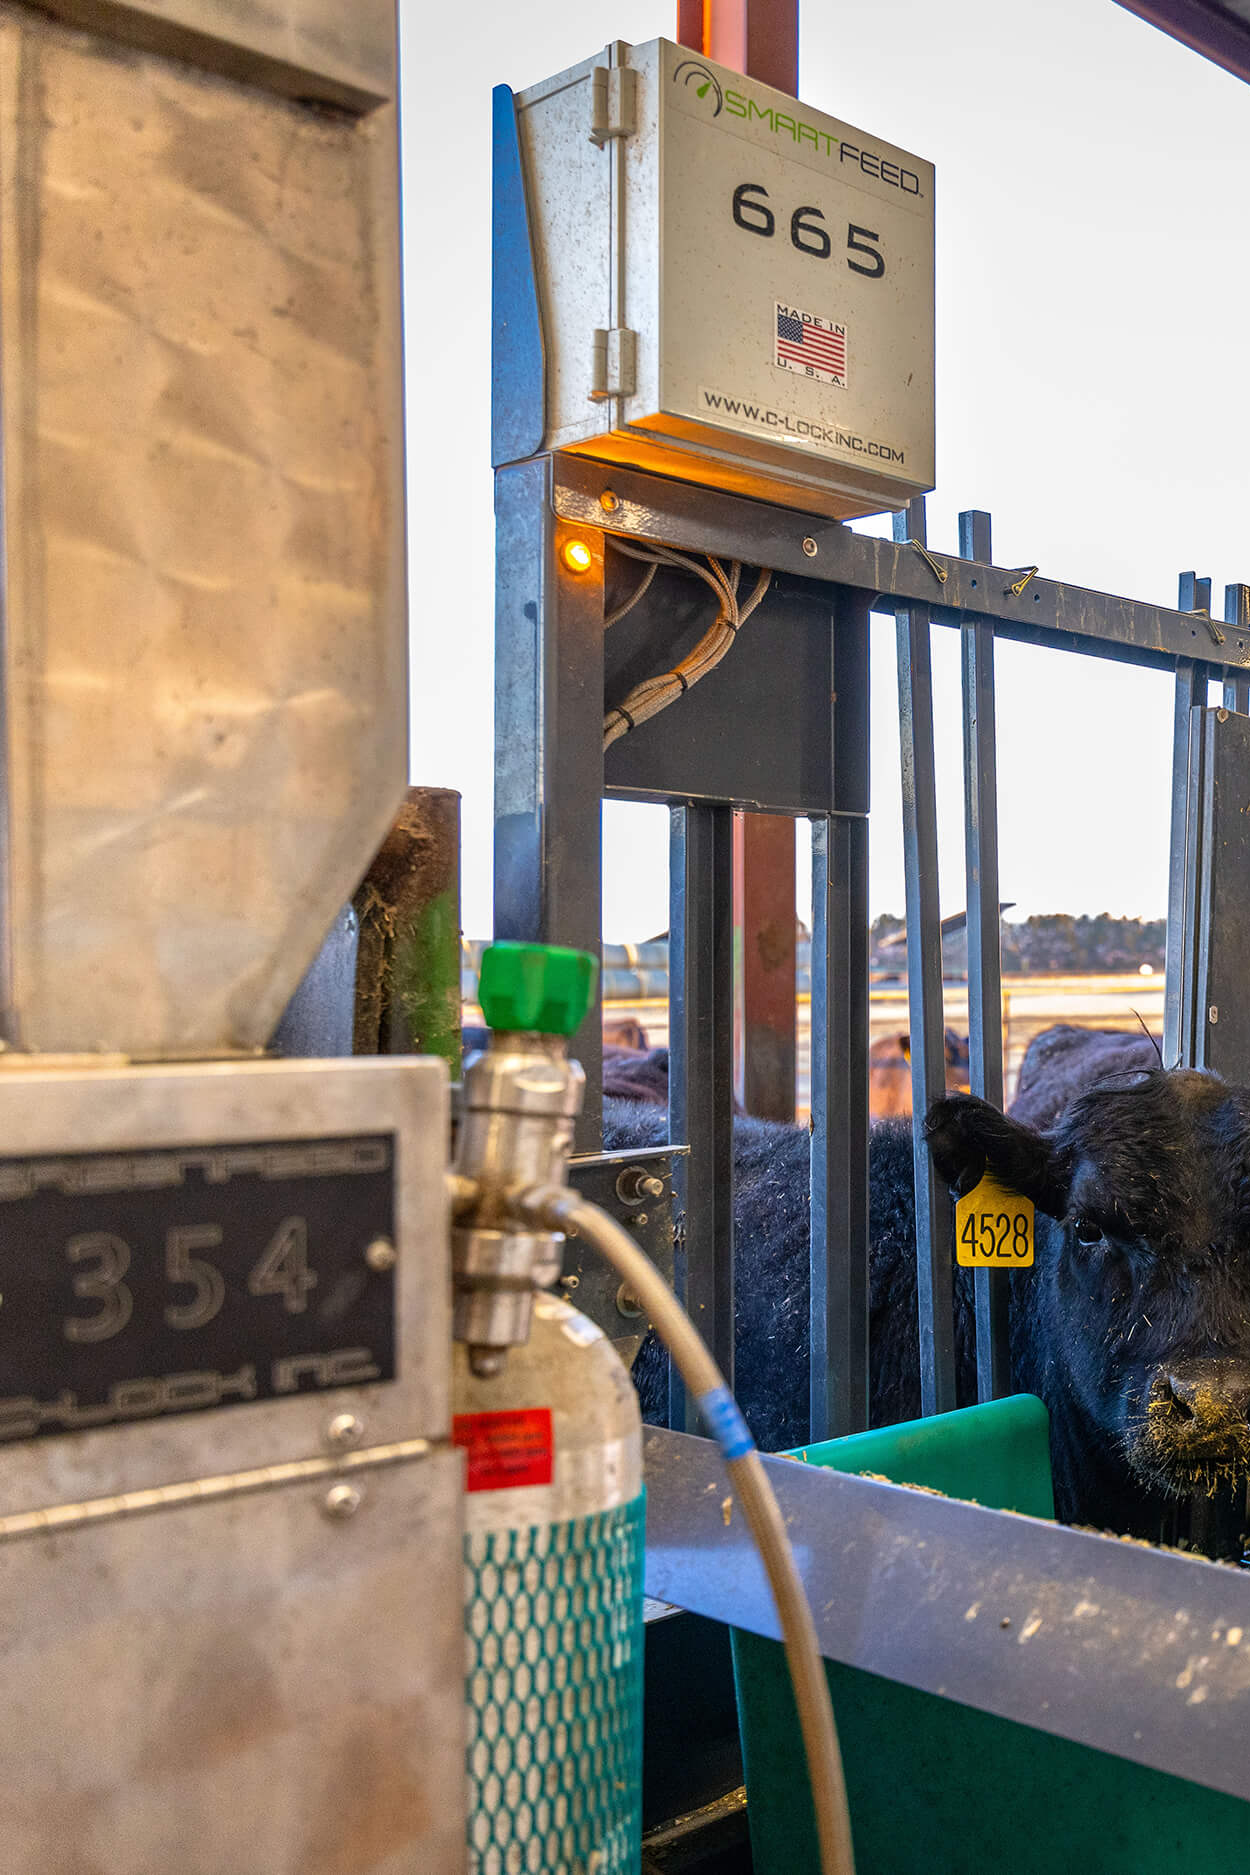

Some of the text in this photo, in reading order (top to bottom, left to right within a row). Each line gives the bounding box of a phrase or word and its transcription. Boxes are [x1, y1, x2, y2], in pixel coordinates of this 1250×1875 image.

[725, 89, 920, 196] SMARTFEED
[732, 183, 886, 279] 665
[776, 303, 846, 336] MADE IN
[704, 391, 905, 465] WWW.C-LOCKINC.COM
[961, 1213, 1029, 1258] 4528
[64, 1215, 319, 1343] 354
